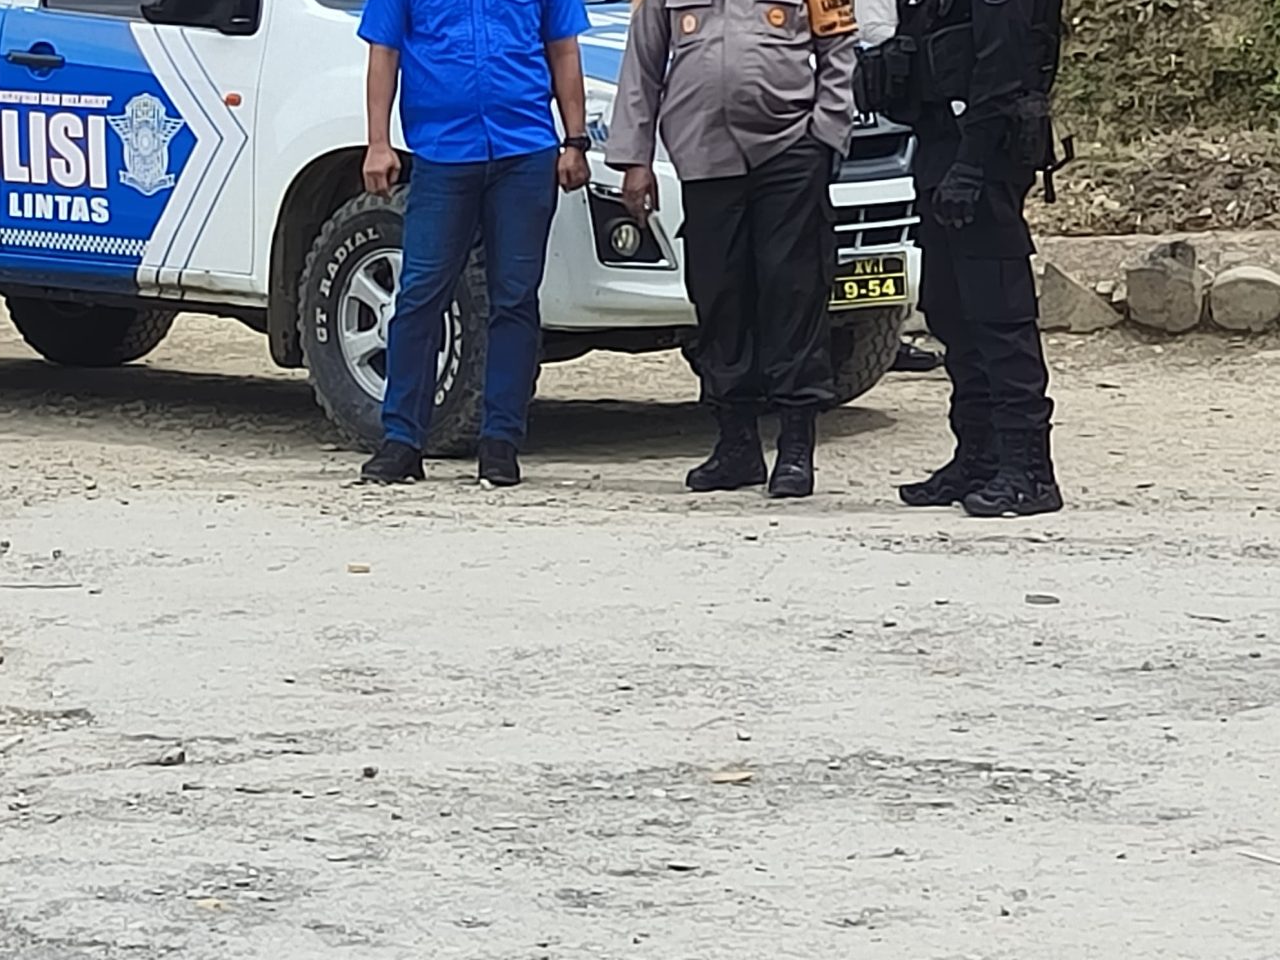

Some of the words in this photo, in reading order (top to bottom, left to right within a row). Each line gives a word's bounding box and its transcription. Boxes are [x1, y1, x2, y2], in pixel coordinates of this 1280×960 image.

[8, 191, 110, 224] LINTAS
[319, 227, 380, 298] RADIAL
[844, 278, 896, 299] 9-54
[315, 307, 329, 343] GT
